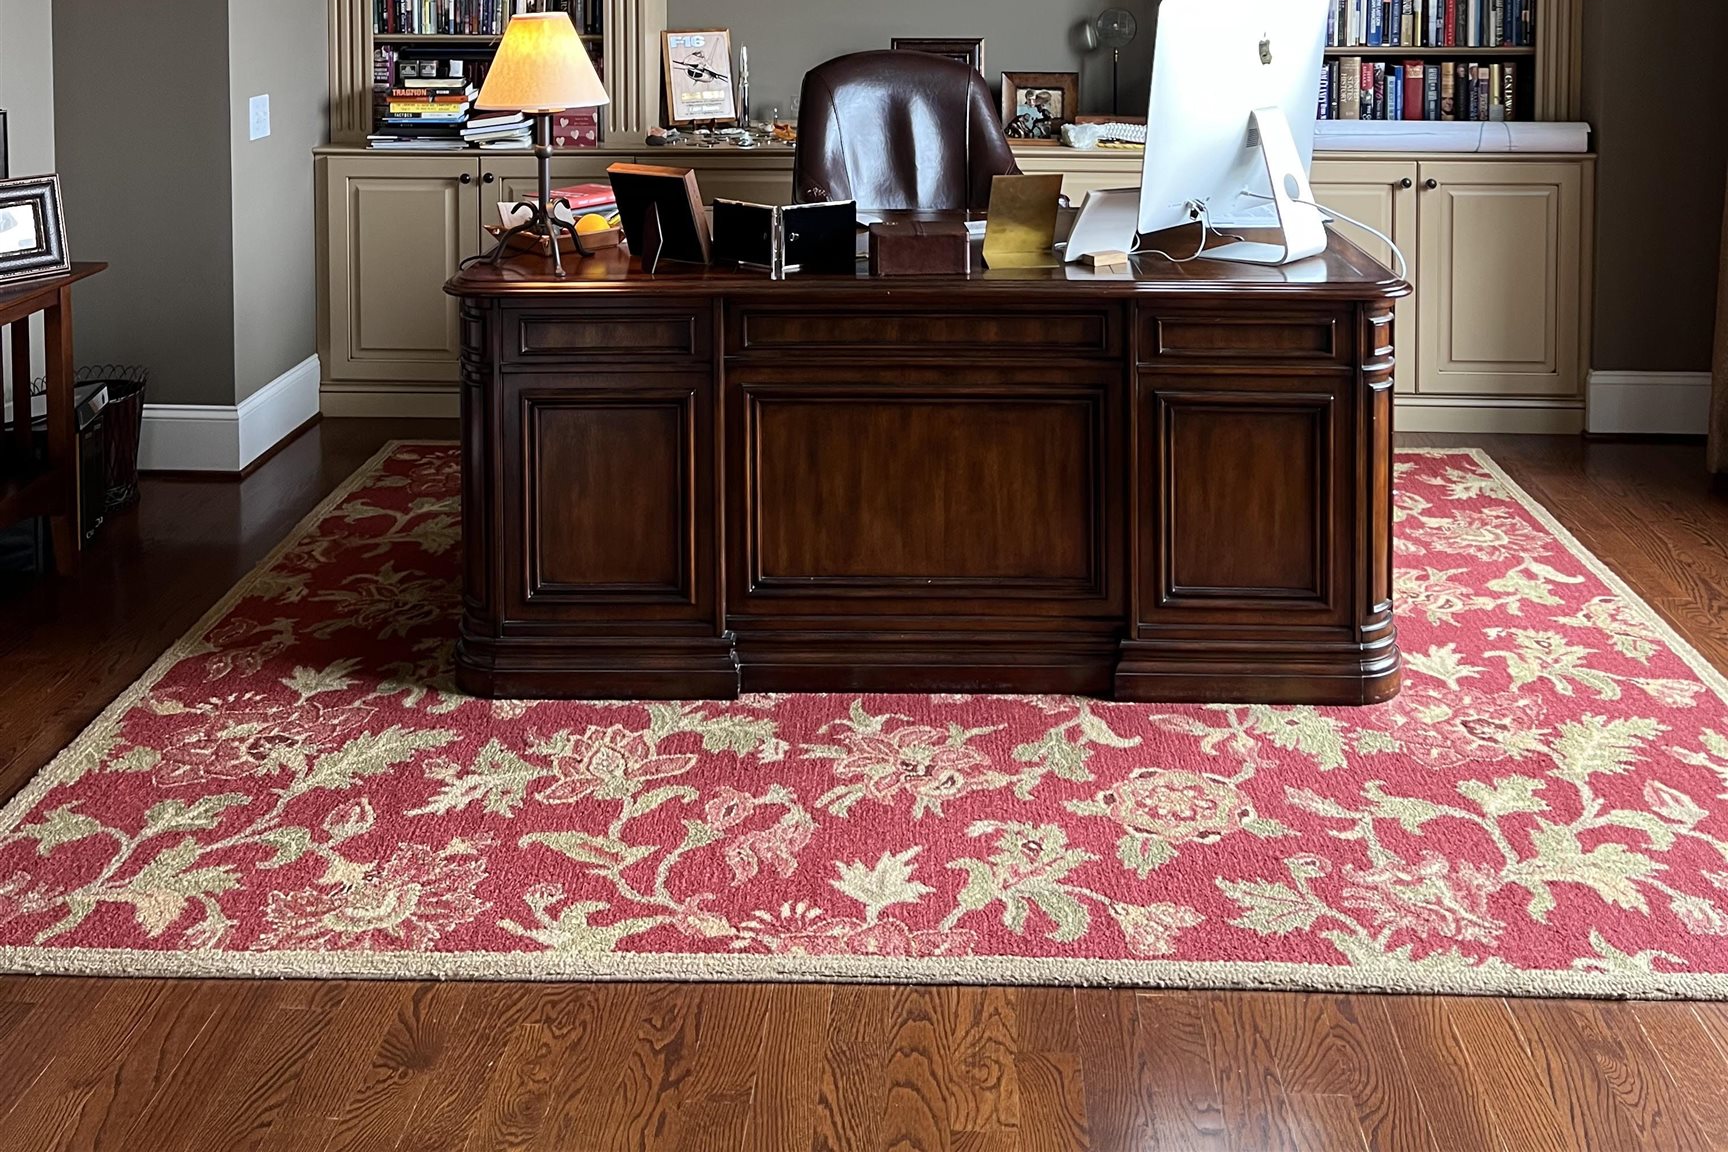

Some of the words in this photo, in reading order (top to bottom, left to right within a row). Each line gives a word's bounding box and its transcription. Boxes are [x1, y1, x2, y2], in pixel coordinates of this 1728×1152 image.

[670, 35, 705, 49] F-16
[393, 89, 427, 97] TRACTION
[1340, 73, 1348, 104] HISTORY
[1375, 81, 1384, 99] 1776
[1505, 90, 1513, 117] LEWIS
